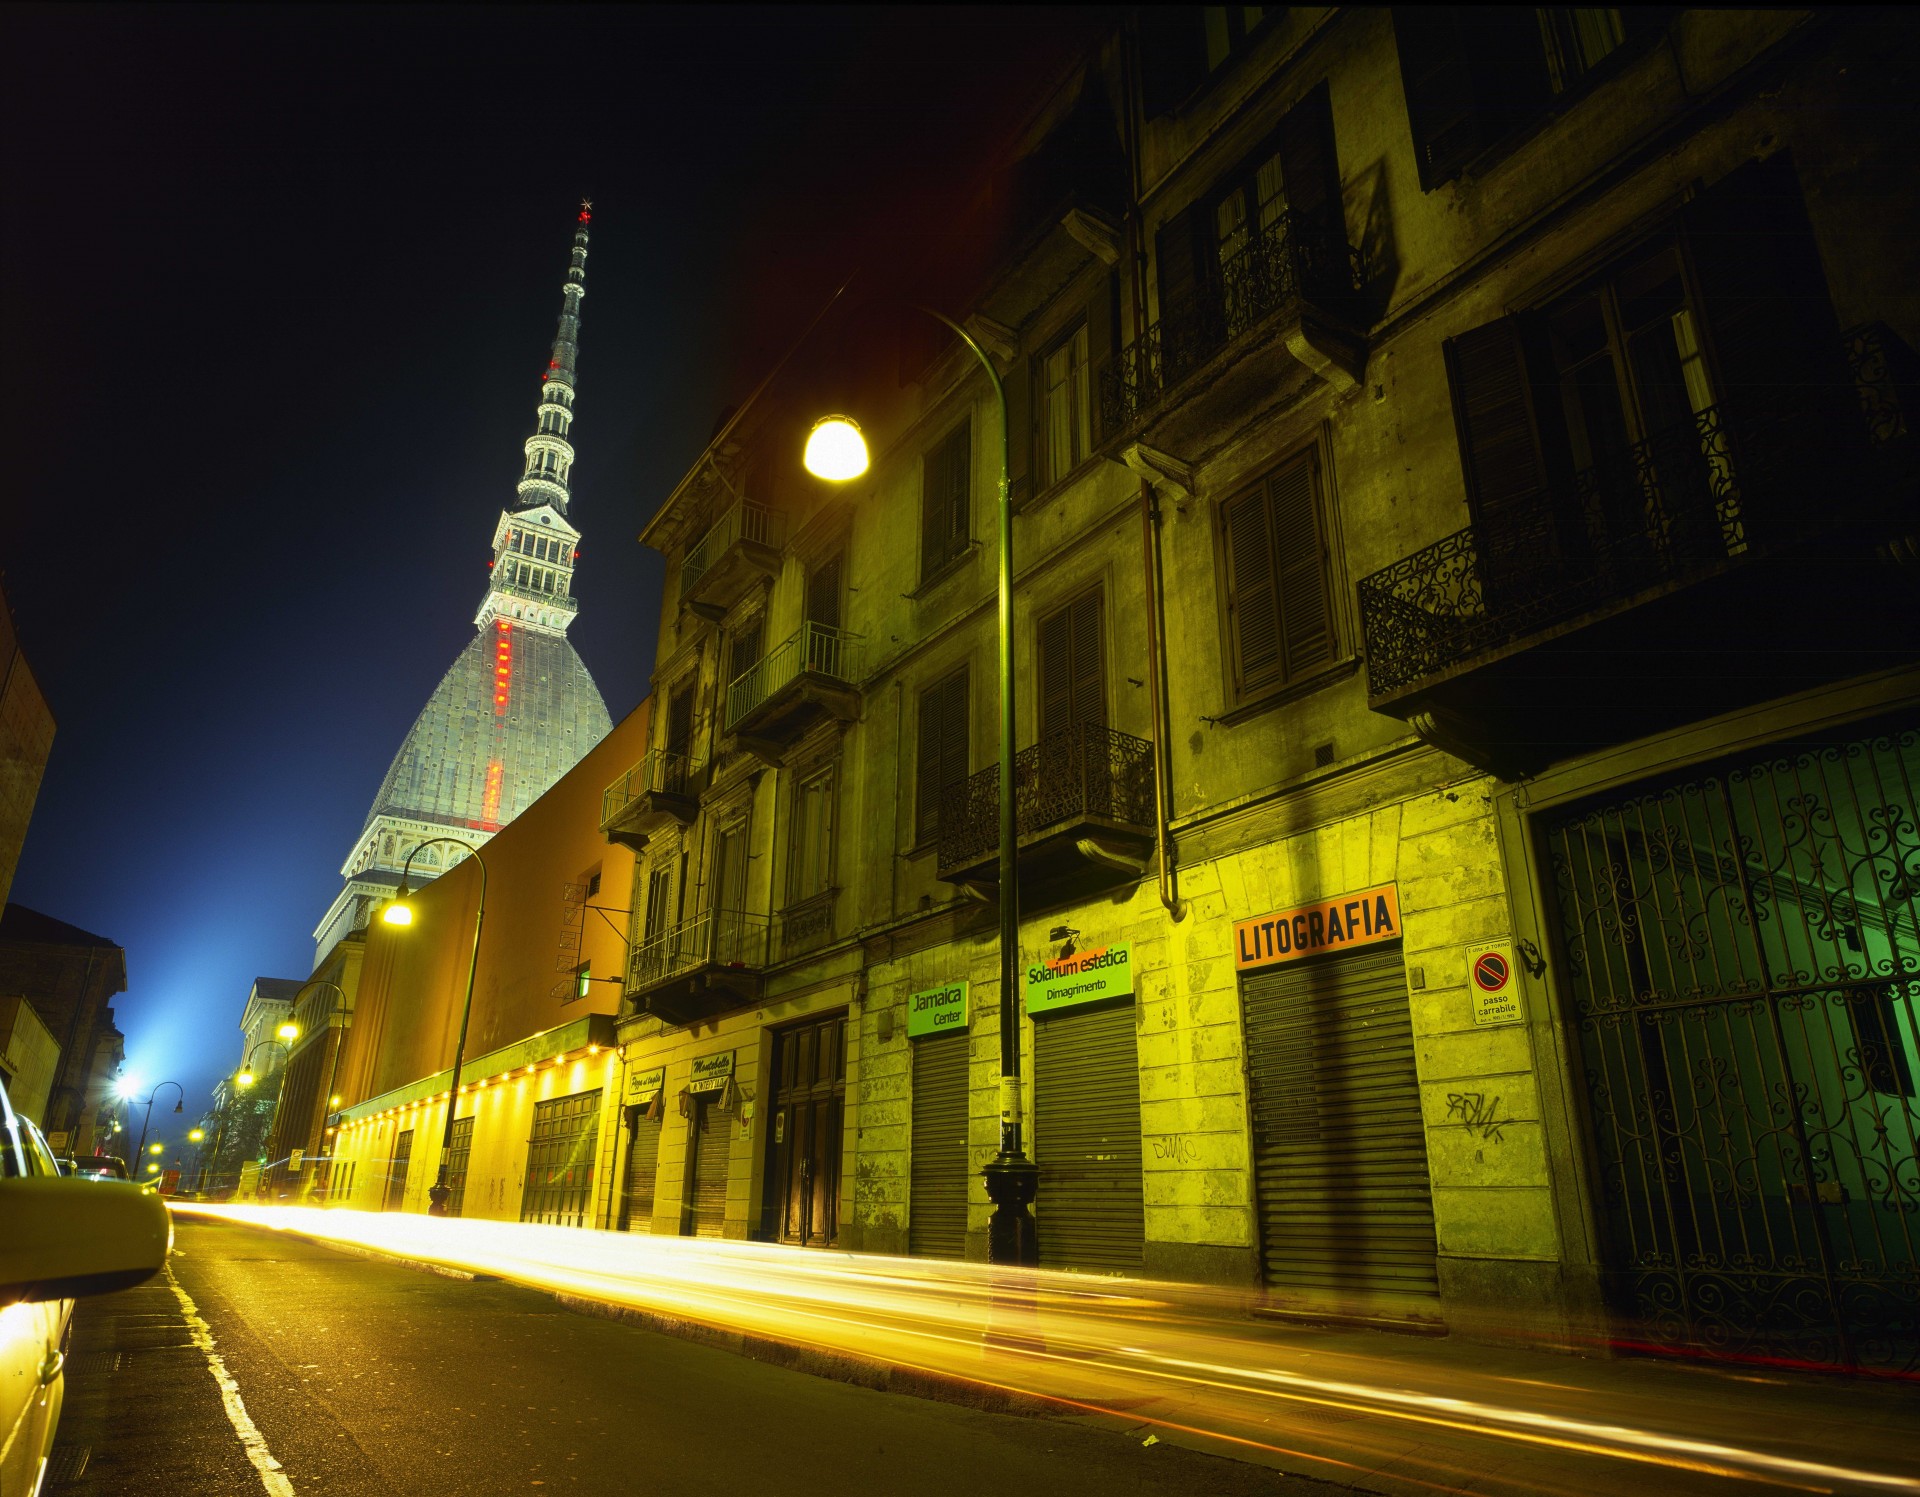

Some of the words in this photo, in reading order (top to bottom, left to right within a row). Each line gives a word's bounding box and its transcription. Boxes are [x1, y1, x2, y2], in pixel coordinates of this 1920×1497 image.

[1239, 895, 1394, 963] LITOGRAFIA
[1028, 961, 1078, 985] Solarium
[1080, 948, 1128, 973] estetica
[913, 987, 962, 1012] Jamaica
[1046, 979, 1107, 1001] Dimagrimento
[1483, 995, 1508, 1006] passo
[933, 1010, 962, 1026] Center
[1478, 1003, 1516, 1015] carrabile
